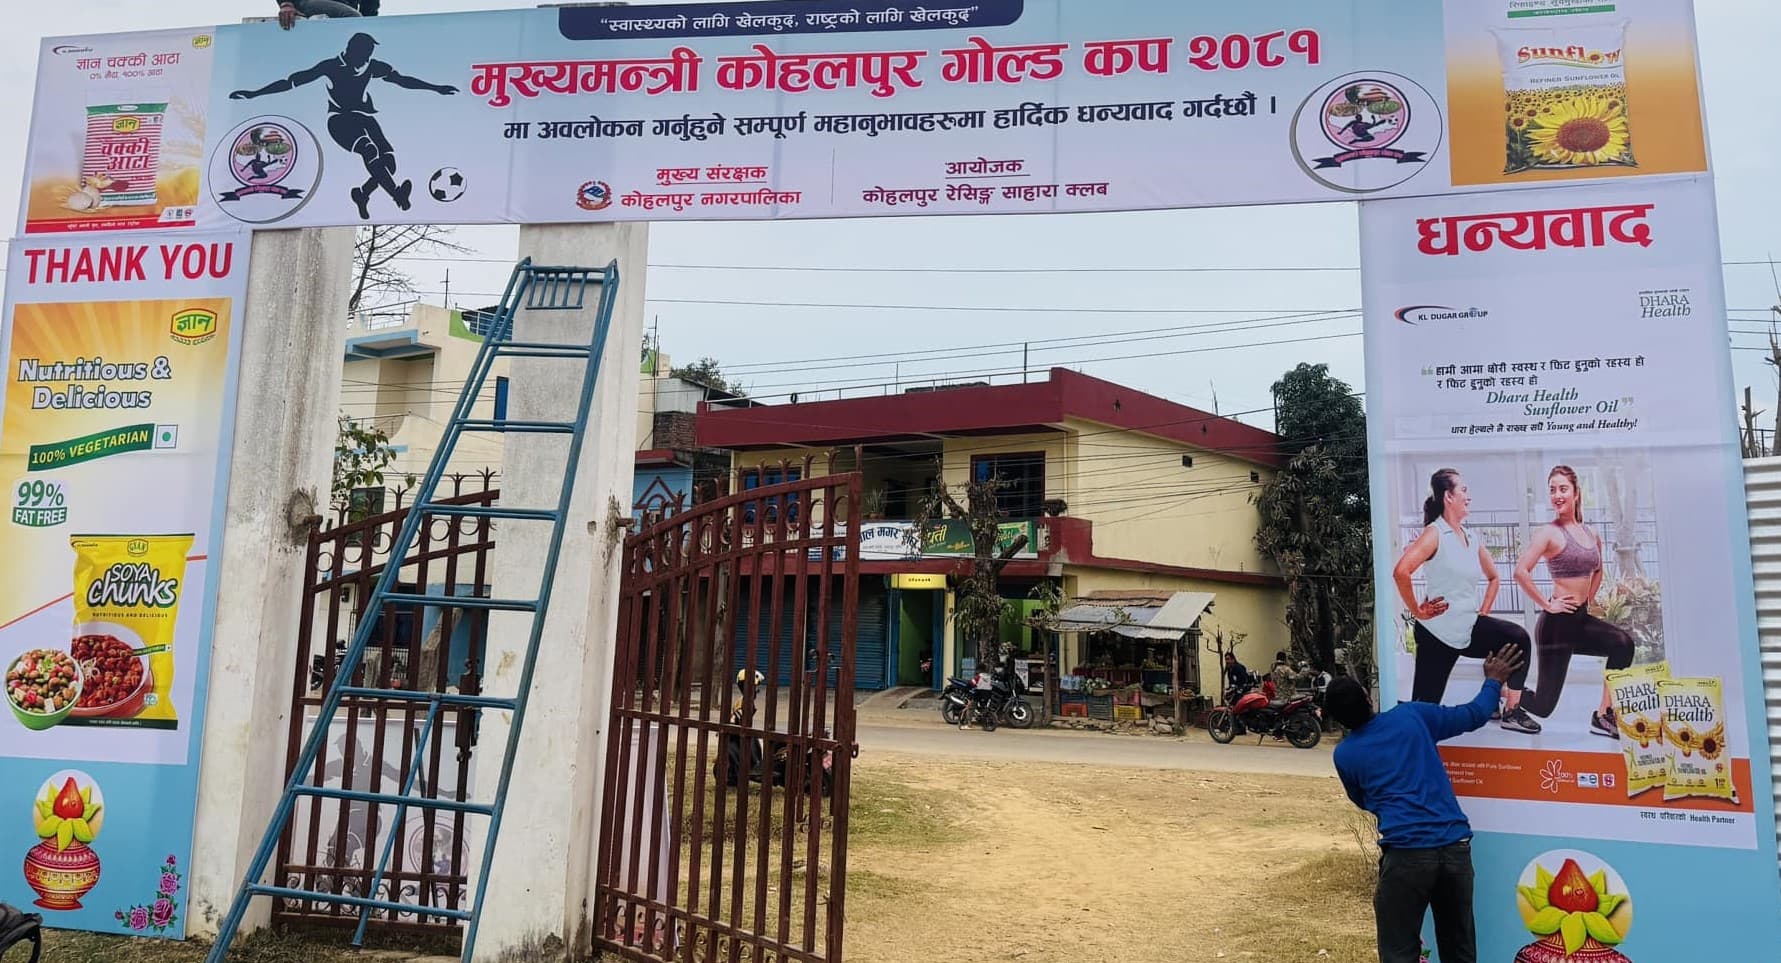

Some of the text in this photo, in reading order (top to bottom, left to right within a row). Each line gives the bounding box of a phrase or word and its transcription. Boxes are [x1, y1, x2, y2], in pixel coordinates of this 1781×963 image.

[600, 6, 979, 32] “स्वास्थ्यको लागि खेलकुद, राष्ट्रको लागि खेलकुद”
[76, 52, 181, 71] ज्ञान चक्की आटा
[471, 28, 1321, 106] मुख्यमन्त्री कोहलपुर गोल्ड कप २०८१
[504, 122, 530, 139] मा
[537, 115, 645, 139] अवलोकन
[652, 113, 726, 141] गर्नुहुने
[733, 111, 807, 139] सम्पूर्ण
[993, 102, 1070, 129] हार्दिक
[1077, 101, 1175, 123] धन्यवाद
[101, 137, 150, 155] चक्की
[107, 155, 151, 170] आटा
[945, 157, 1024, 175] आयोजक
[656, 164, 769, 186] मुख्य संरक्षक
[620, 188, 802, 211] कोहलपुर नगरपालिका
[862, 186, 940, 207] कोहलपुर
[1002, 184, 1060, 201] साहारा
[1065, 182, 1110, 197] क्लब
[1416, 203, 1655, 258] धन्यवाद
[24, 242, 233, 285] THANK YOU
[1640, 294, 1690, 306] DHARA
[1642, 304, 1691, 318] Health
[175, 313, 214, 332] ज्ञान
[17, 356, 172, 382] Nutritious &
[1460, 365, 1483, 375] आमा
[1511, 362, 1538, 372] स्वस्थ
[1540, 361, 1546, 371] र
[1550, 359, 1571, 370] फिट
[1605, 358, 1631, 368] रहस्य
[1635, 355, 1645, 367] हो
[1437, 380, 1443, 389] र
[1446, 378, 1467, 389] फिट
[1500, 377, 1525, 386] रहस्य
[1529, 375, 1537, 385] हो
[32, 384, 152, 409] Delicious
[1486, 388, 1579, 404] Dhara Health
[1523, 400, 1618, 419] Sunflower Oil
[1546, 421, 1574, 432] Young
[1576, 420, 1595, 430] and
[1597, 418, 1637, 430] Healthy!
[31, 429, 149, 465] 100% VEGETARIAN
[18, 480, 64, 506] 99%
[15, 508, 66, 525] FAT FREE
[111, 563, 152, 583] SOYA
[88, 570, 177, 605] chunks
[1664, 695, 1712, 708] DHARA
[1668, 708, 1713, 722] Health
[1690, 814, 1711, 823] Health
[1711, 816, 1735, 824] Partner
